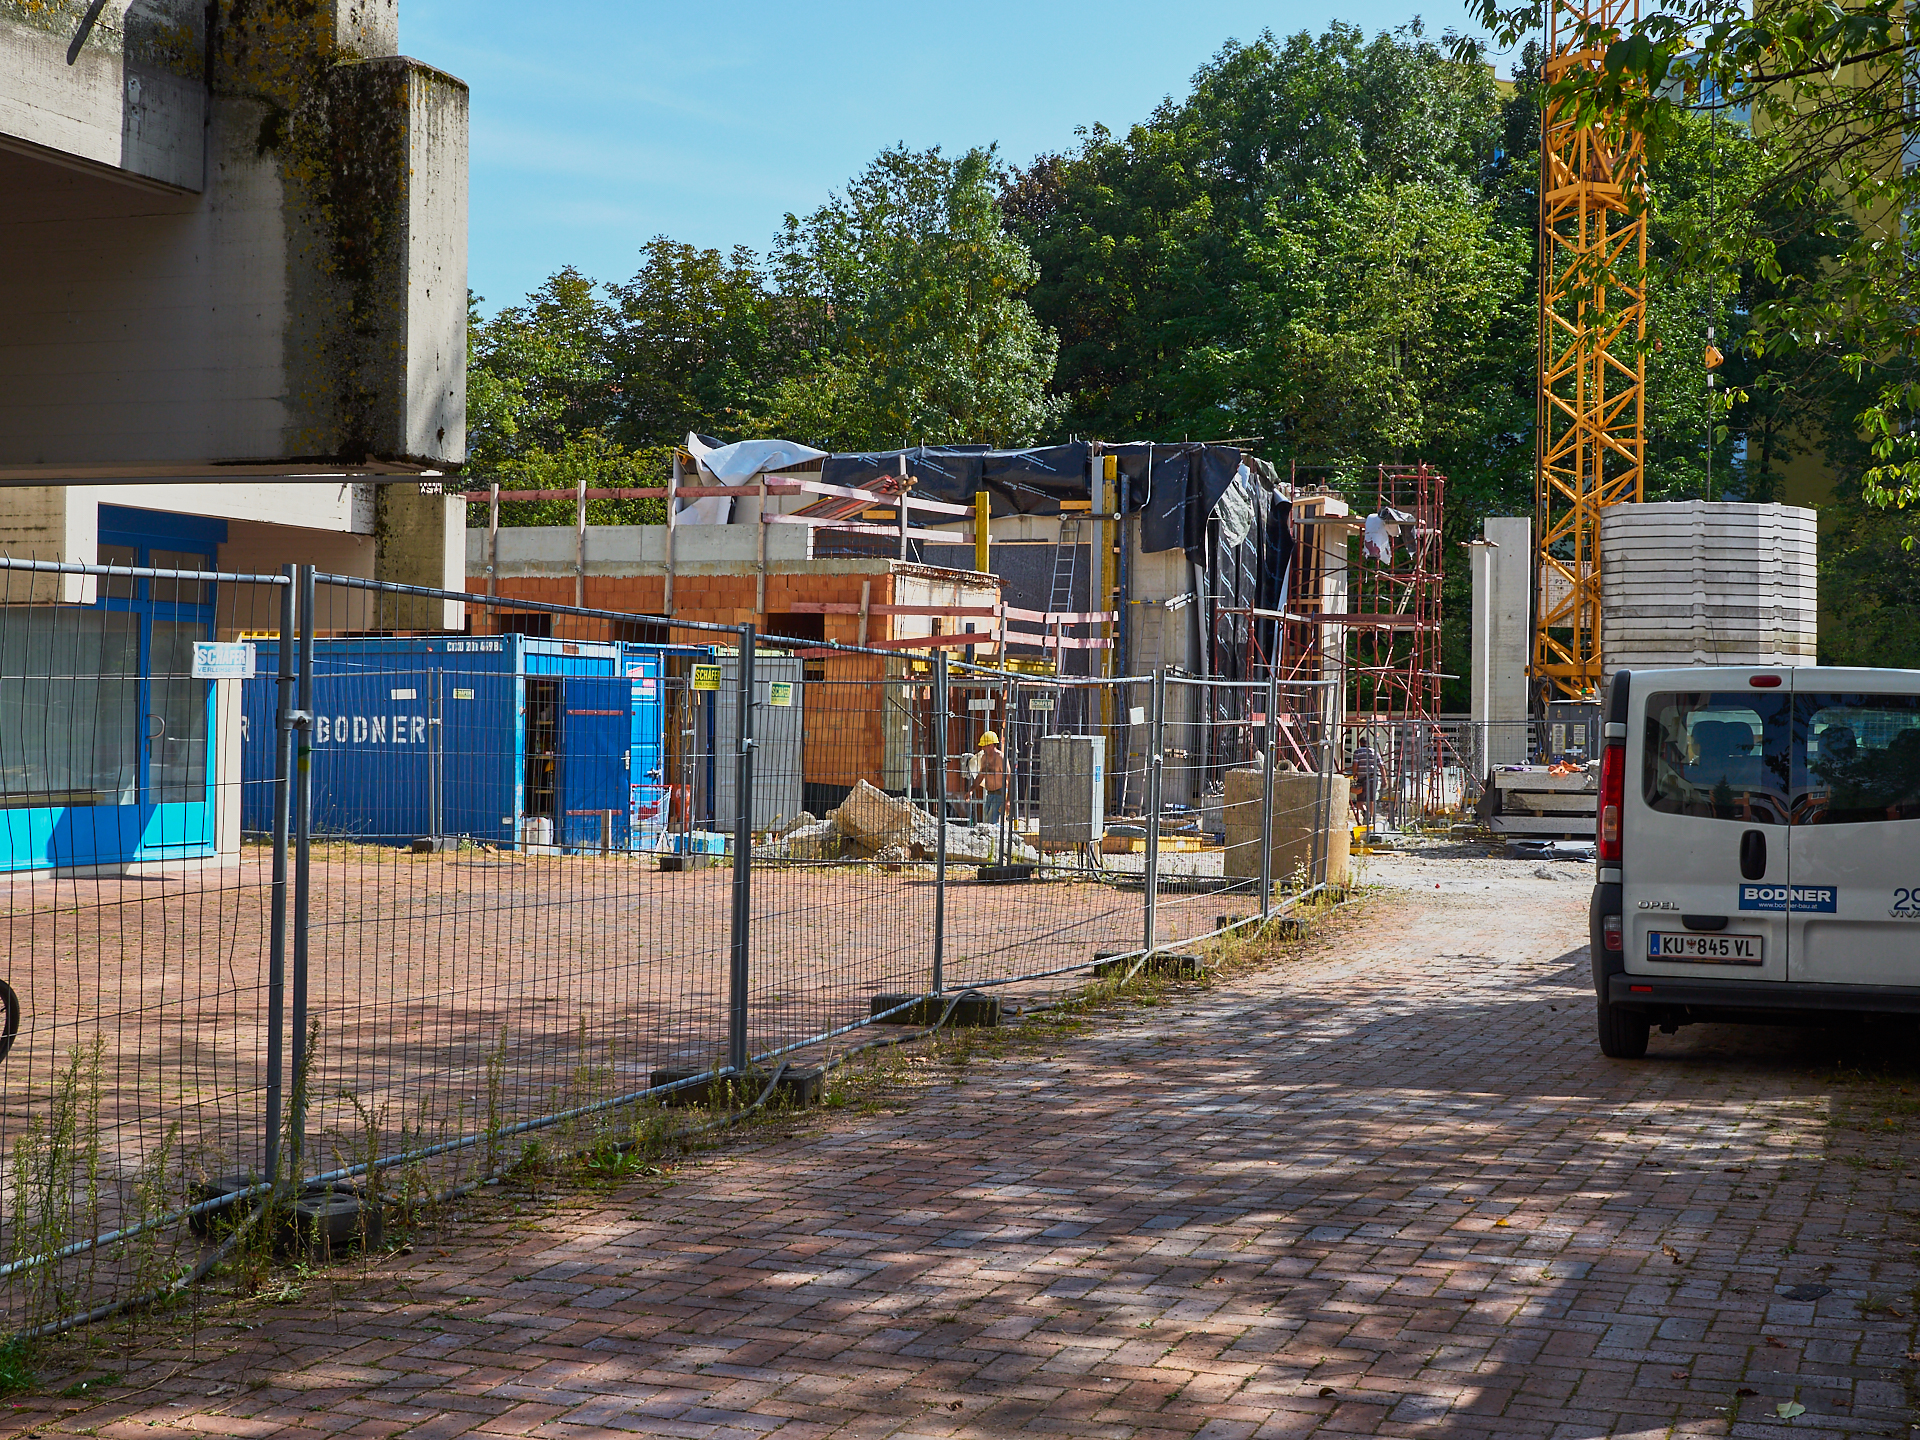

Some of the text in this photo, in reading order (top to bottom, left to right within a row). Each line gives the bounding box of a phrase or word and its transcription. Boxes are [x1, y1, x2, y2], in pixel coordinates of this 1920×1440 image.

[316, 716, 425, 743] BODNER
[1744, 888, 1832, 902] BODNER
[1637, 900, 1680, 911] OPEL
[1663, 937, 1754, 957] KU 845 VL
